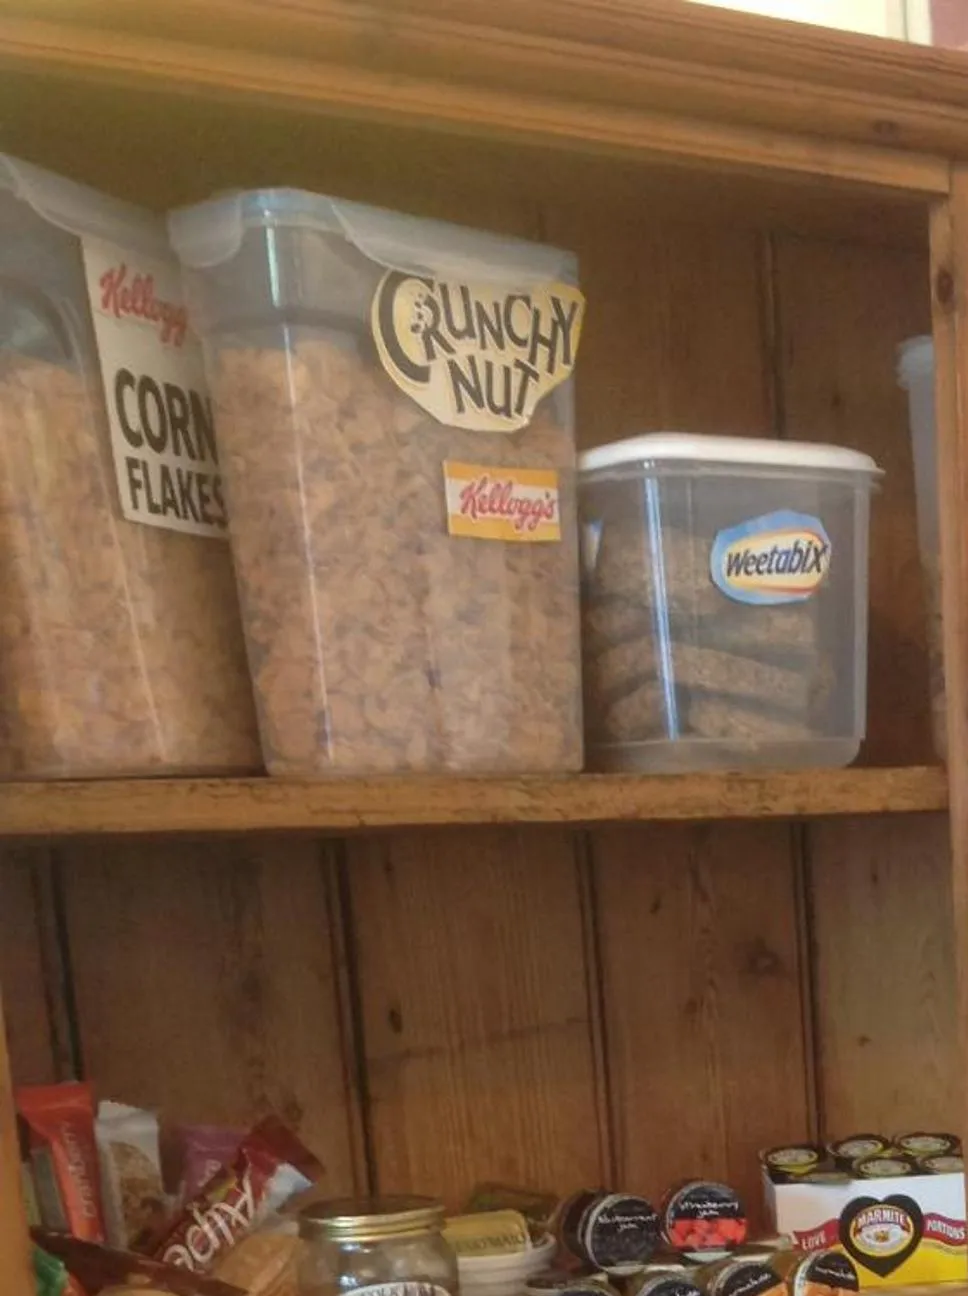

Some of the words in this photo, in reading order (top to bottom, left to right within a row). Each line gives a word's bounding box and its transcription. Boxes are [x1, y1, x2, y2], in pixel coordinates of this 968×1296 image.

[98, 262, 188, 347] Kellogg
[379, 269, 579, 384] CRUNCHY
[114, 367, 219, 467] CORN
[447, 355, 540, 419] NUT
[125, 456, 230, 528] FLAKES
[459, 476, 556, 532] Kellogg's
[163, 1148, 259, 1273] Alpe
[802, 1230, 827, 1251] LOVE
[857, 1209, 907, 1226] MARMITE
[926, 1219, 966, 1241] PORTIONS
